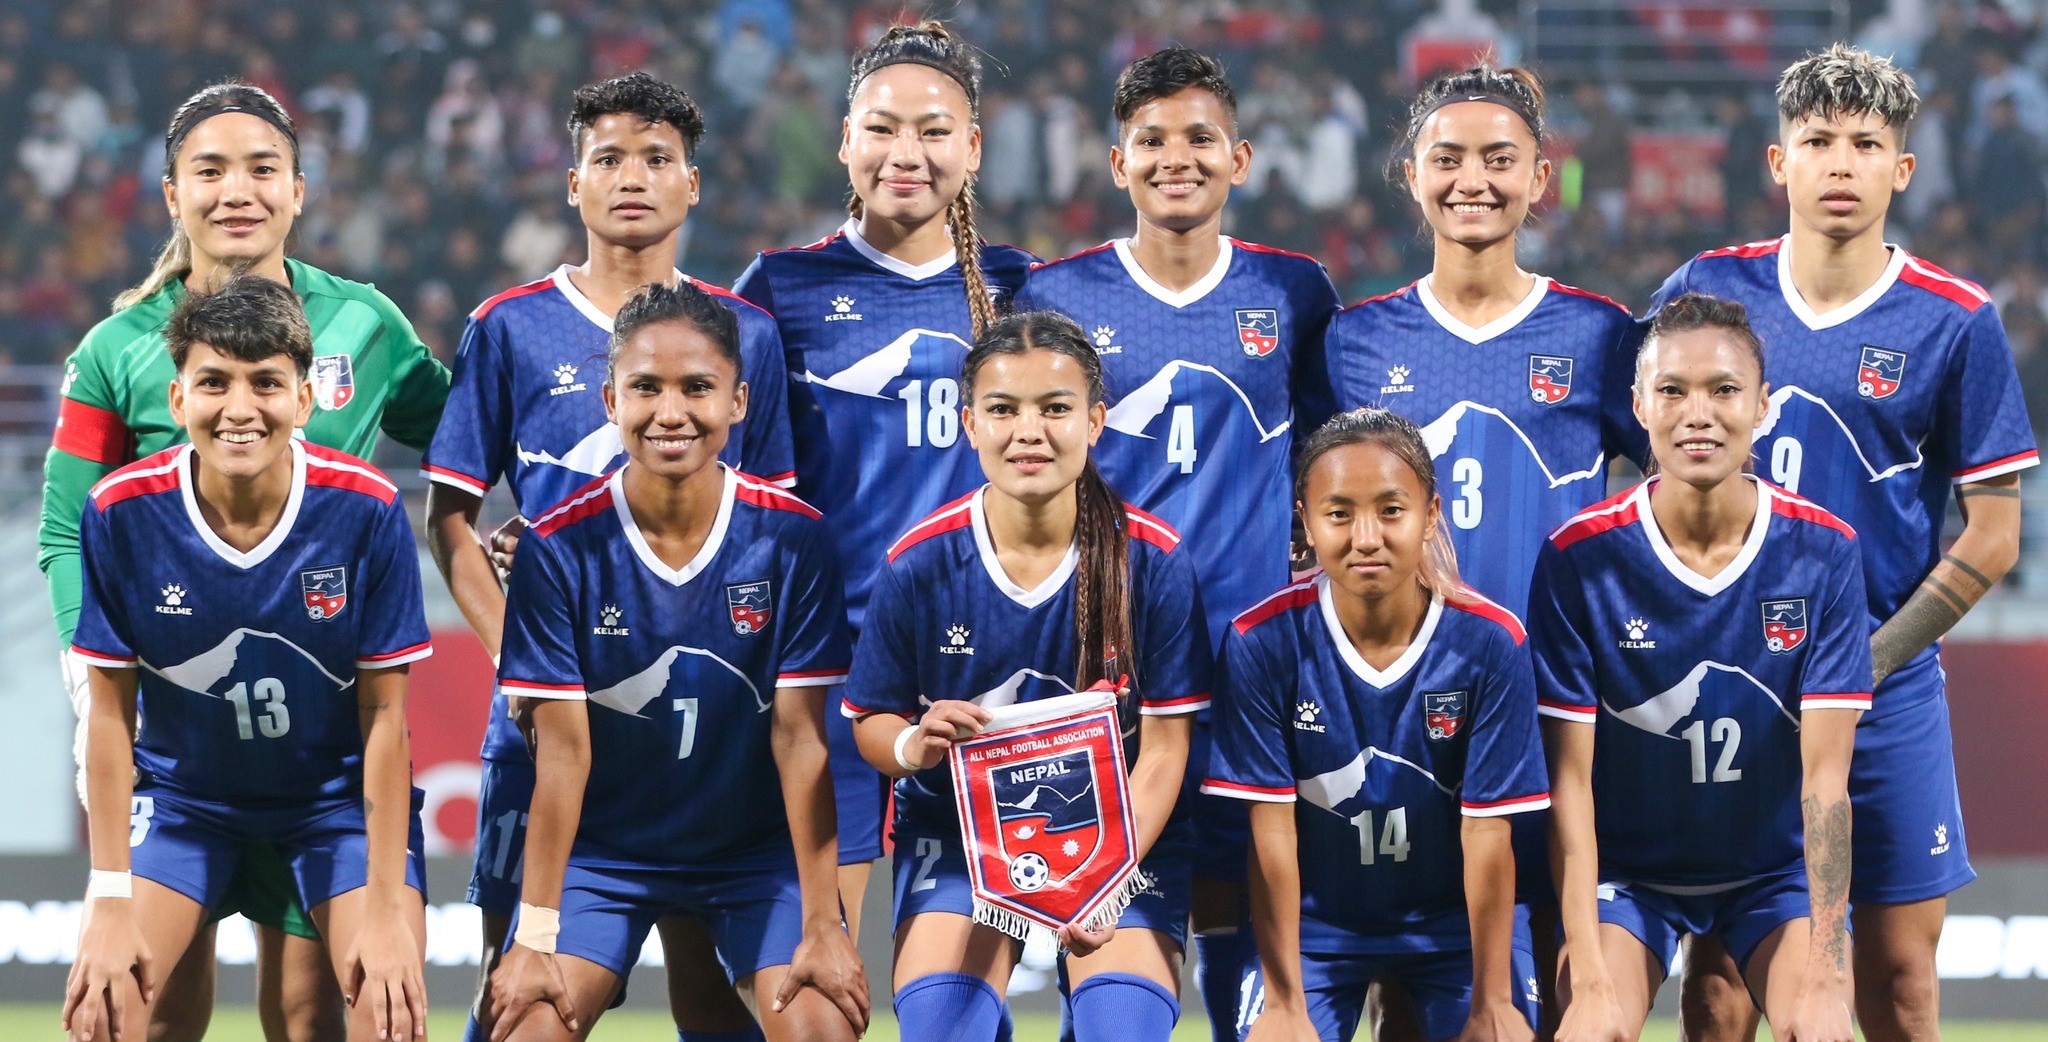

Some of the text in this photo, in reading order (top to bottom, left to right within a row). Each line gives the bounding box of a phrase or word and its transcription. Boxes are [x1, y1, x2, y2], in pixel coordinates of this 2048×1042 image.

[824, 313, 863, 322] KELME
[1095, 345, 1123, 355] ELME
[1874, 351, 1894, 361] NEPAL
[1541, 359, 1562, 367] NEPAL
[549, 383, 587, 396] KELME
[1380, 385, 1415, 394] KELME
[898, 377, 960, 449] 18
[1166, 405, 1197, 474] 4
[1770, 436, 1803, 495] 9
[1451, 457, 1483, 530] 3
[313, 572, 334, 580] NEPAL
[738, 586, 760, 595] NEPAL
[155, 605, 193, 616] KELME
[593, 627, 629, 637] KELME
[939, 645, 975, 656] KELME
[1619, 640, 1657, 650] KELME
[224, 677, 290, 740] 13
[673, 697, 699, 760] 7
[1292, 719, 1326, 733] KELME
[969, 725, 1105, 763] ALL NEPAL FOOTBALL ASSOCIATION
[1681, 717, 1742, 784] 12
[1010, 760, 1071, 785] NEPAL
[1350, 806, 1411, 865] 14
[910, 837, 942, 894] 2
